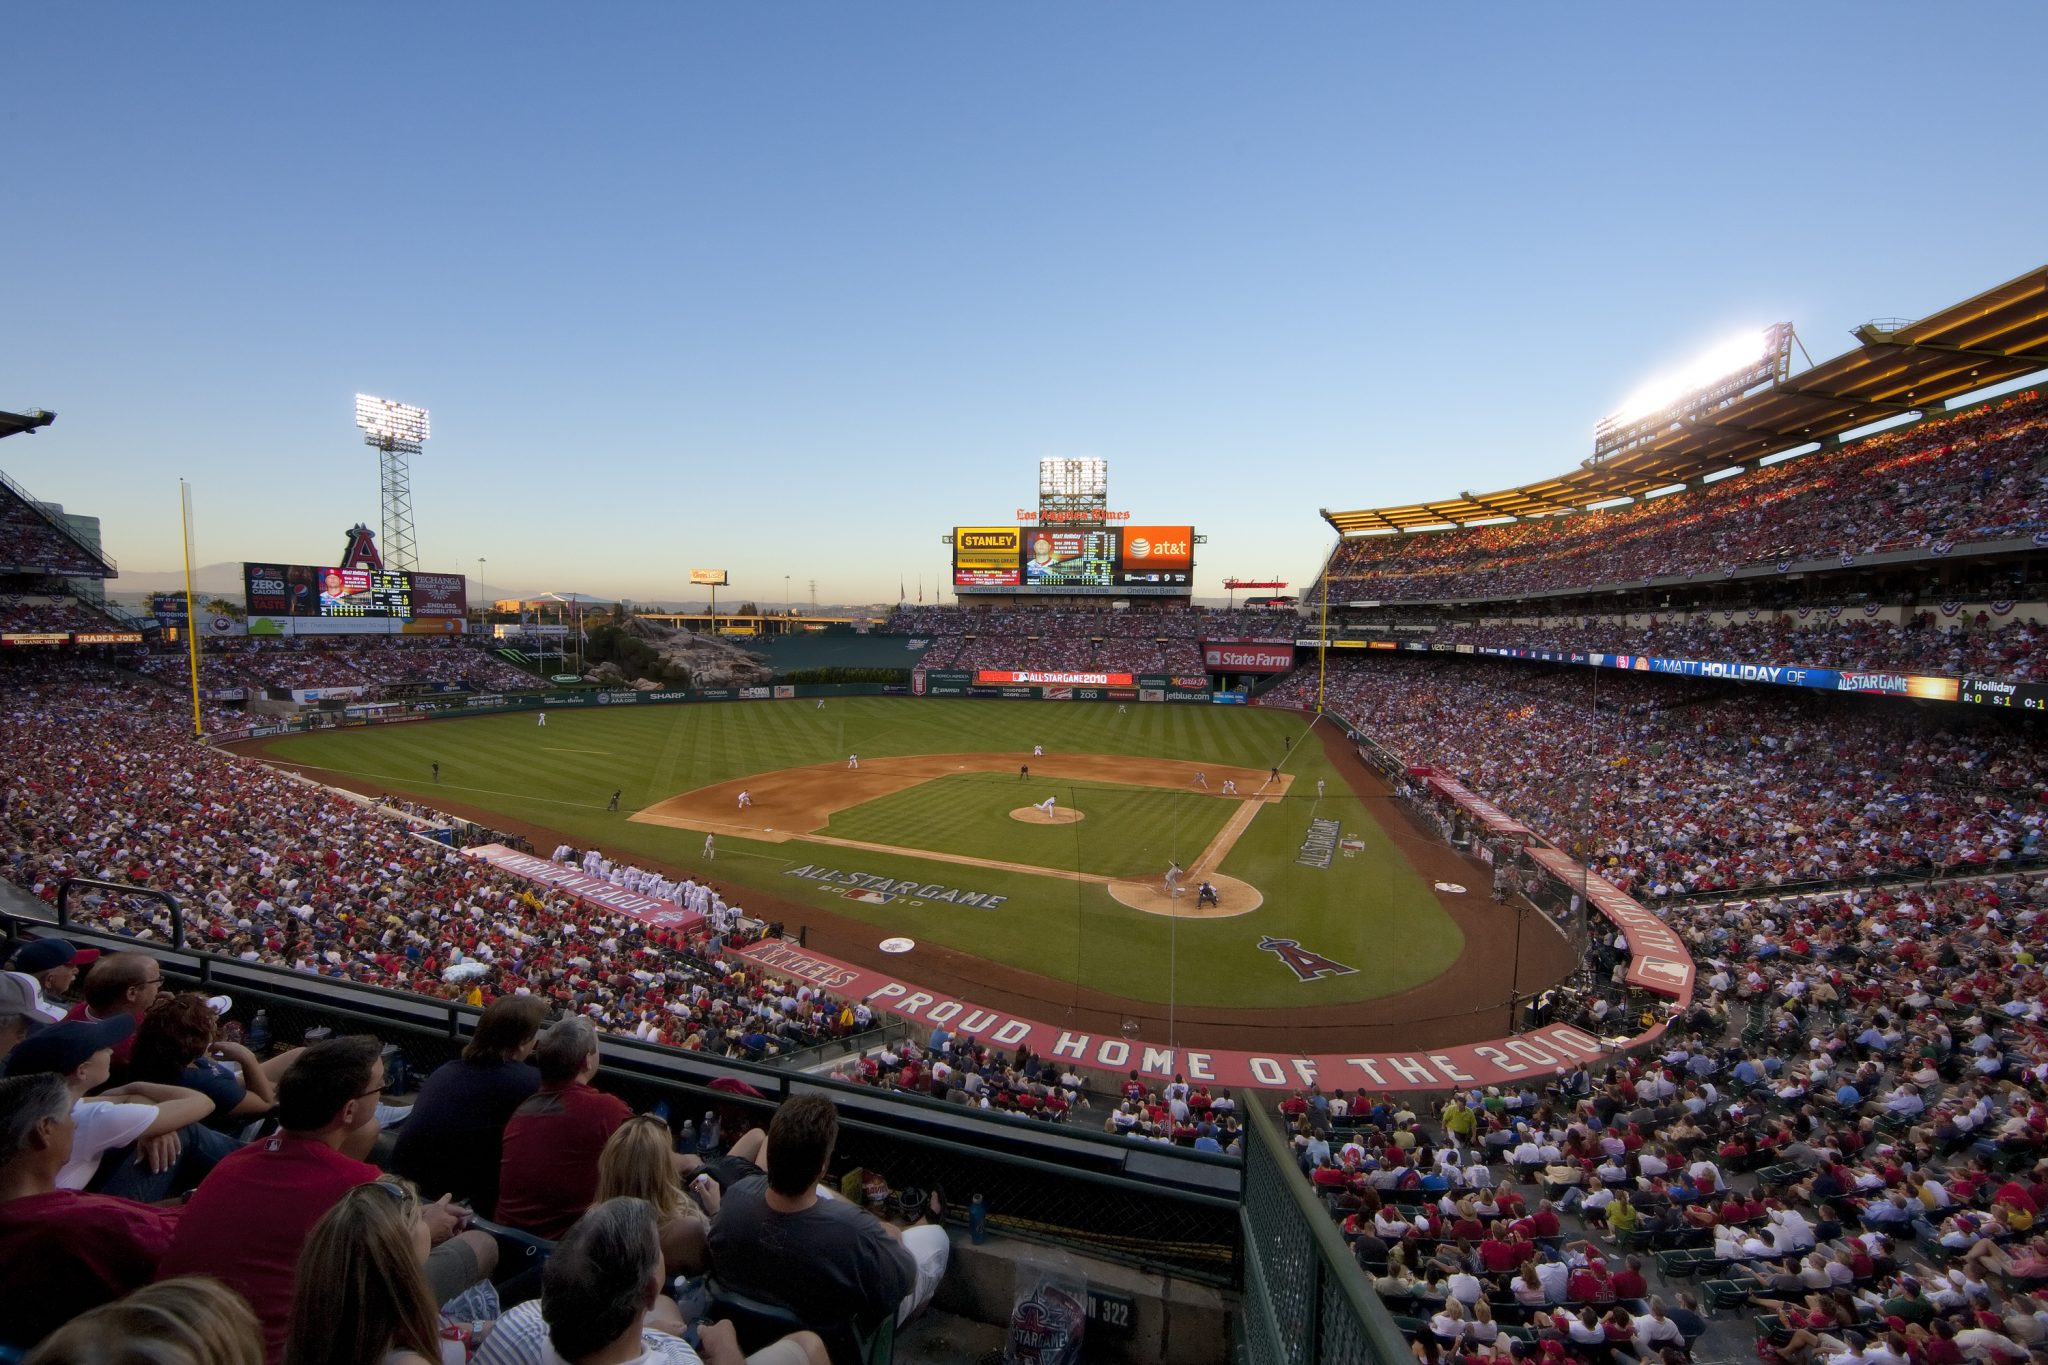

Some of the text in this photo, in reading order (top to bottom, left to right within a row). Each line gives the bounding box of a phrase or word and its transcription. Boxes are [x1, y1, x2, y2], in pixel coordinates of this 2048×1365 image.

[1016, 508, 1130, 522] Los Angeles Times
[965, 536, 1013, 546] STANLEY
[1154, 540, 1186, 555] at&t
[252, 580, 284, 590] ZERO
[414, 576, 460, 584] PECHANGA
[1654, 660, 1807, 683] 7 MATT HOLLIDAY OF
[1063, 673, 1083, 684] GAME
[1084, 674, 1106, 686] 2010
[1879, 675, 1907, 692] GAME
[1962, 680, 2016, 695] 7 Holliday
[1166, 692, 1209, 701] jetblue.com
[494, 854, 661, 914] AMERICAN LEAGUE
[913, 884, 1008, 909] GAME
[744, 944, 860, 988] ANGELS
[1632, 990, 1642, 998] 95
[868, 982, 1600, 1086] PROUD HOME OF THE 2010
[1103, 1300, 1128, 1326] 322
